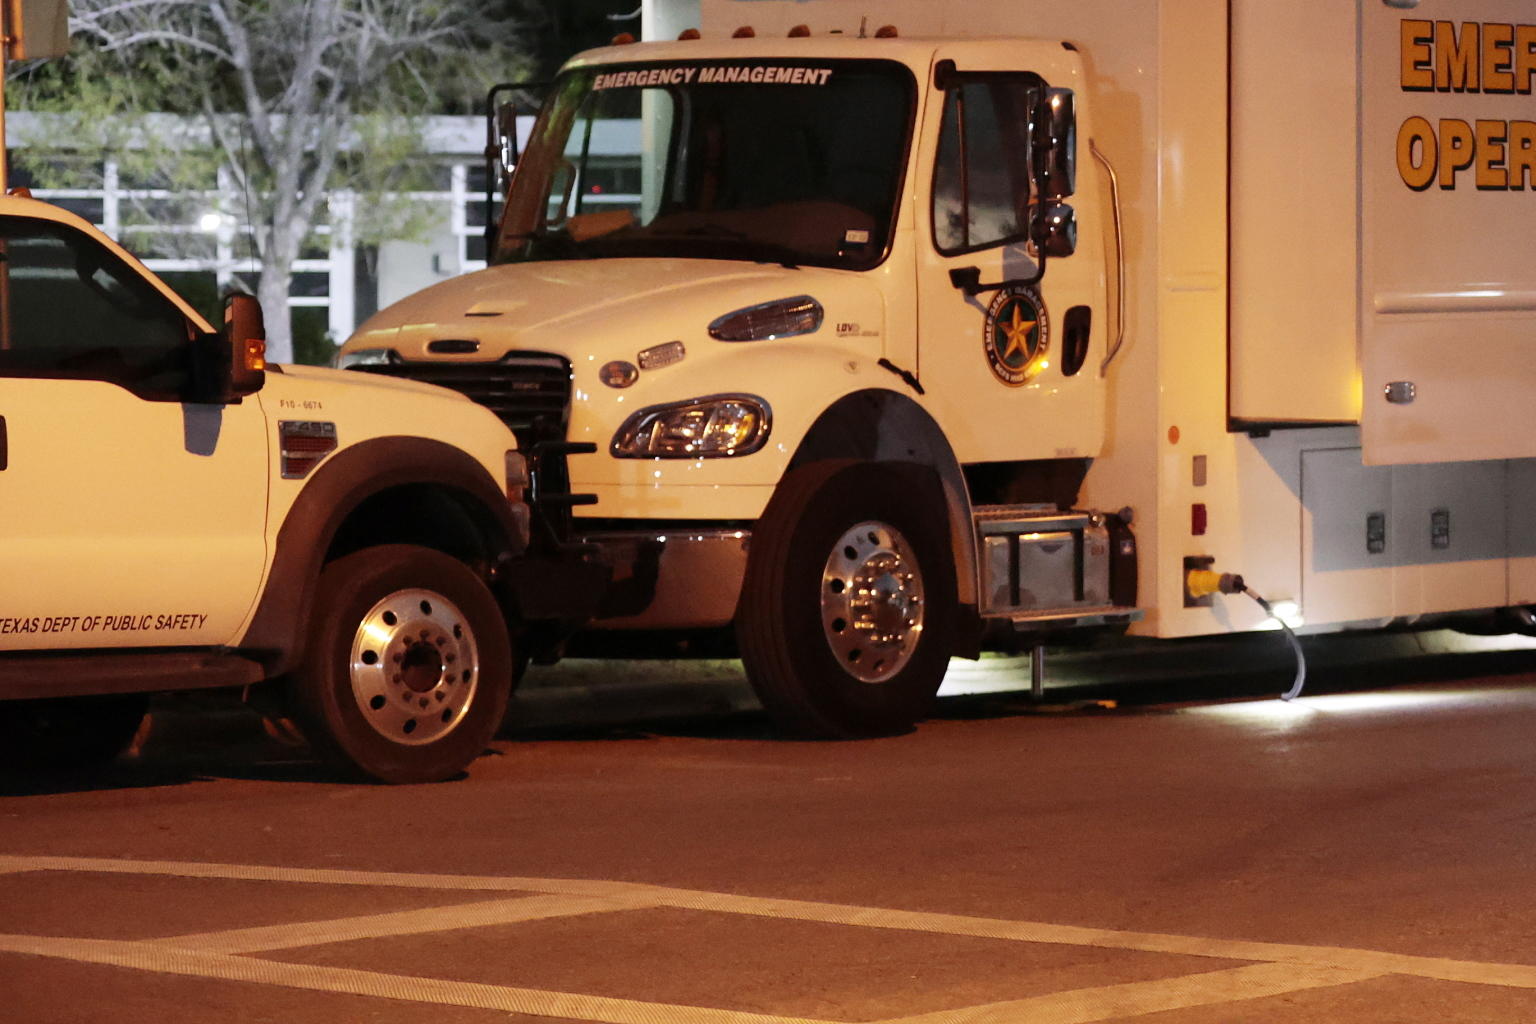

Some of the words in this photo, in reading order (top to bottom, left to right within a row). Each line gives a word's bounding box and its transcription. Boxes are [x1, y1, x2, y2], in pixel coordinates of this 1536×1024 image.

[592, 67, 697, 91] EMERGENCY
[697, 66, 833, 86] MANAGEMENT
[41, 616, 80, 633] DEPT
[81, 615, 102, 632] OF
[102, 614, 153, 631] PUBLIC
[154, 613, 208, 630] SAFETY
